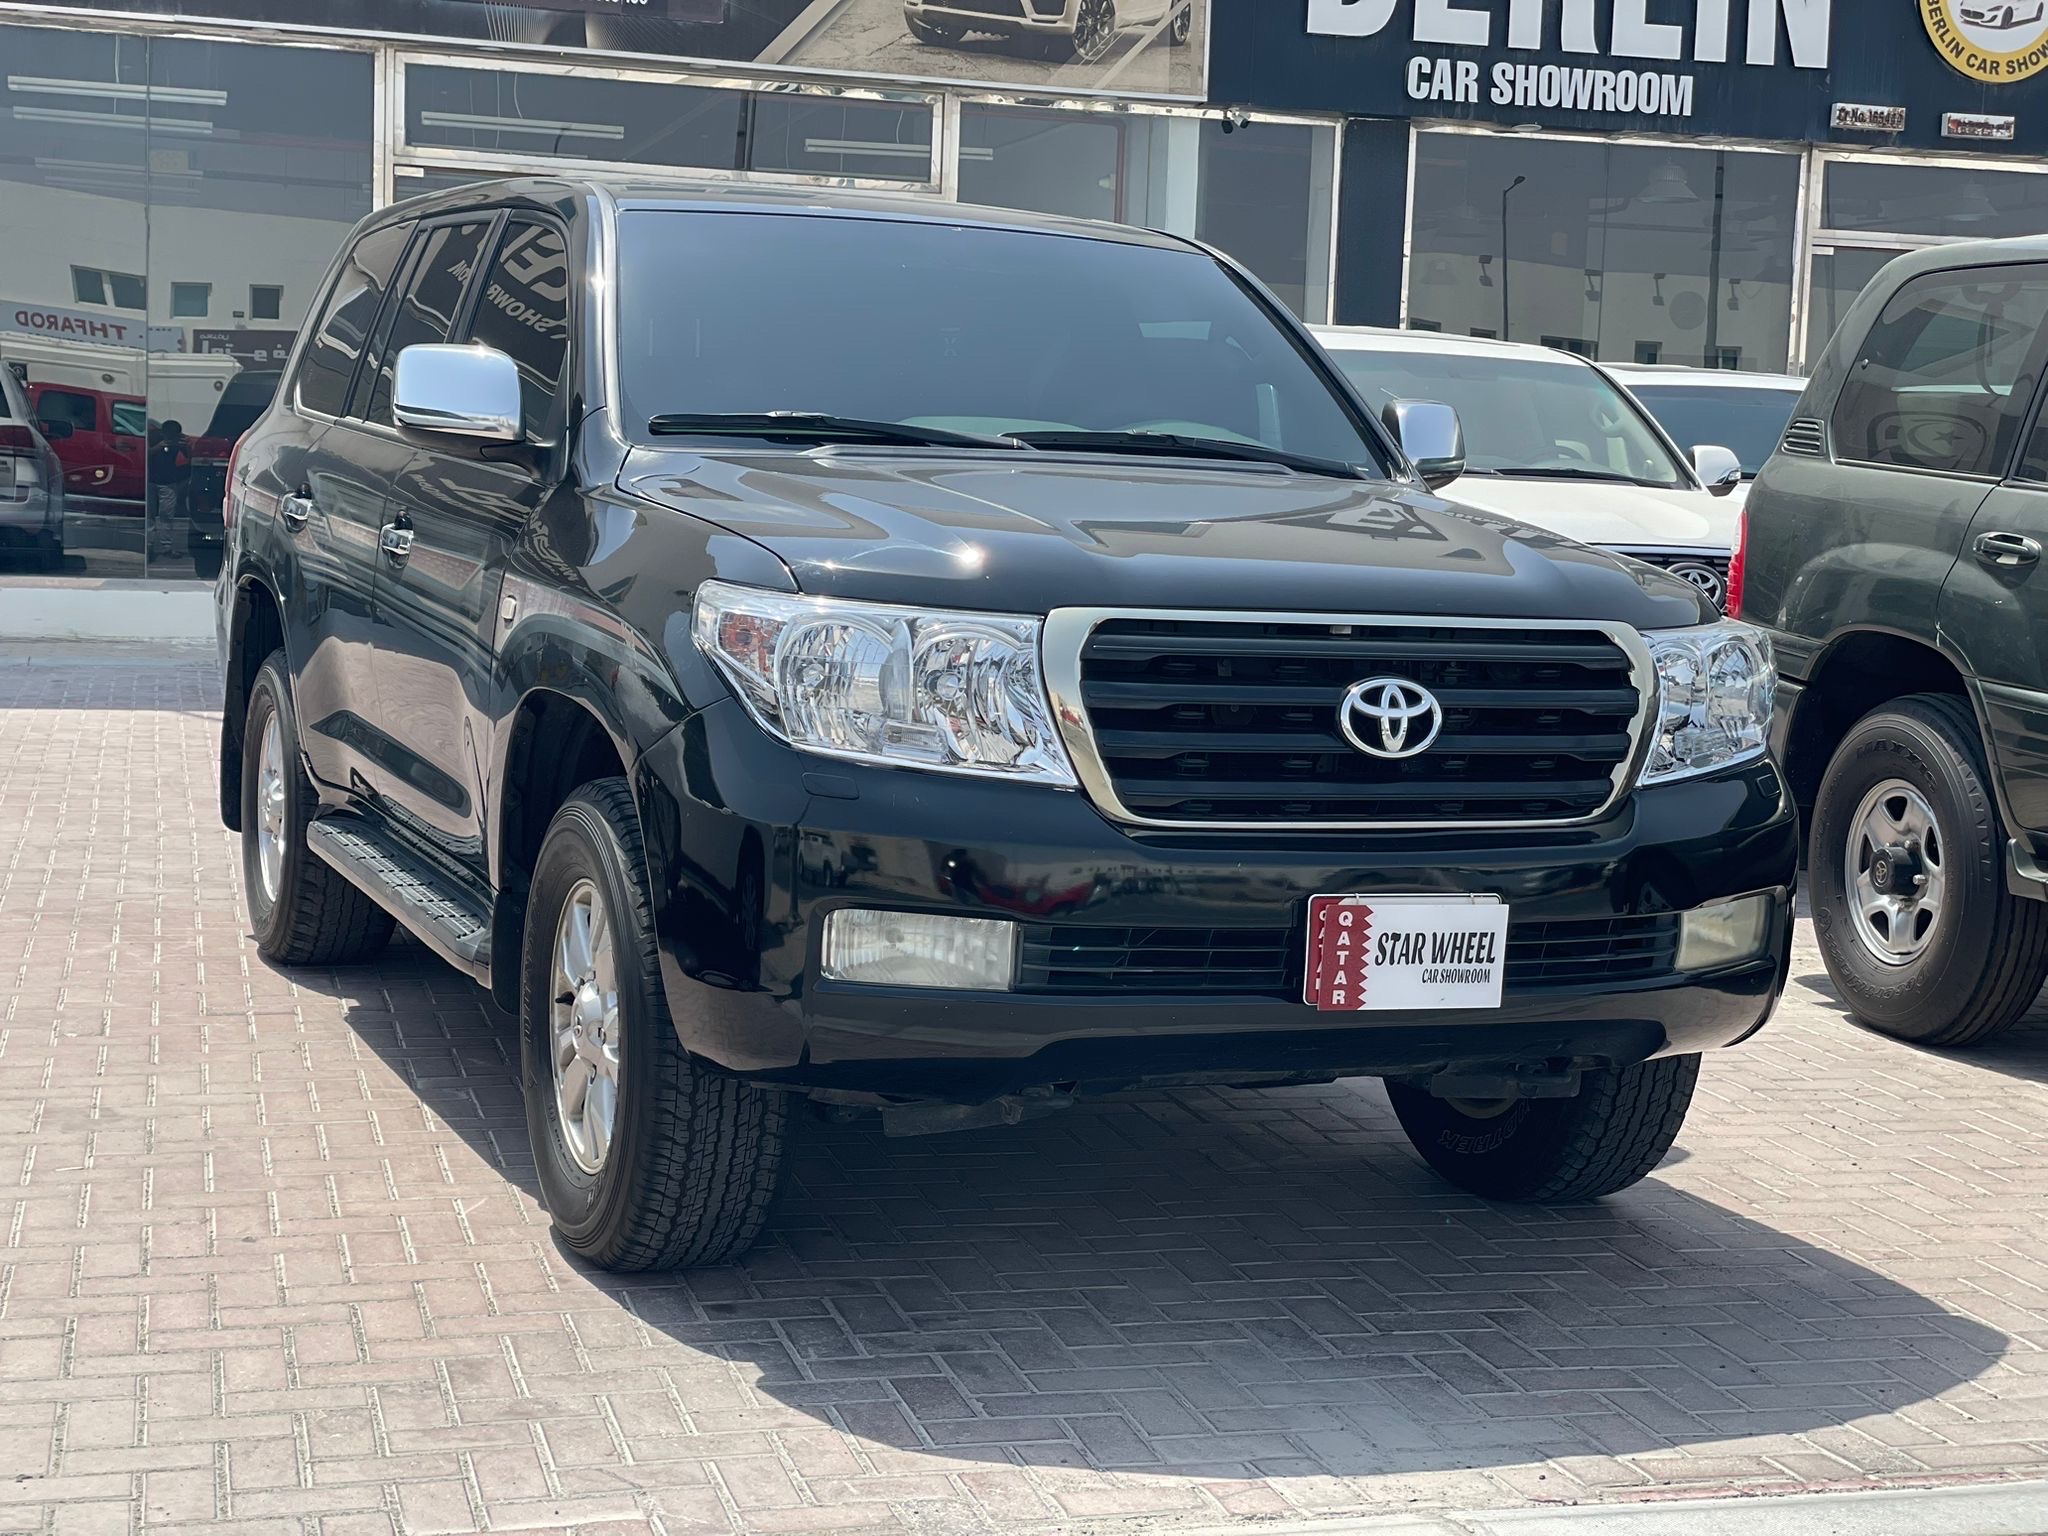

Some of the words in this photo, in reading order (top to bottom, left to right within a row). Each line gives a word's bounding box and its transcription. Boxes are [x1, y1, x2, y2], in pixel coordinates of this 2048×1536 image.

[1966, 53, 2000, 75] CAR
[1407, 56, 1478, 103] CAR
[1490, 61, 1693, 117] SHOWROOM
[1332, 911, 1353, 1004] QATAR
[1374, 932, 1427, 966] STAR
[1431, 931, 1496, 964] WHEEL
[1421, 968, 1438, 984] CAR
[1439, 968, 1491, 984] SHOWROOM
